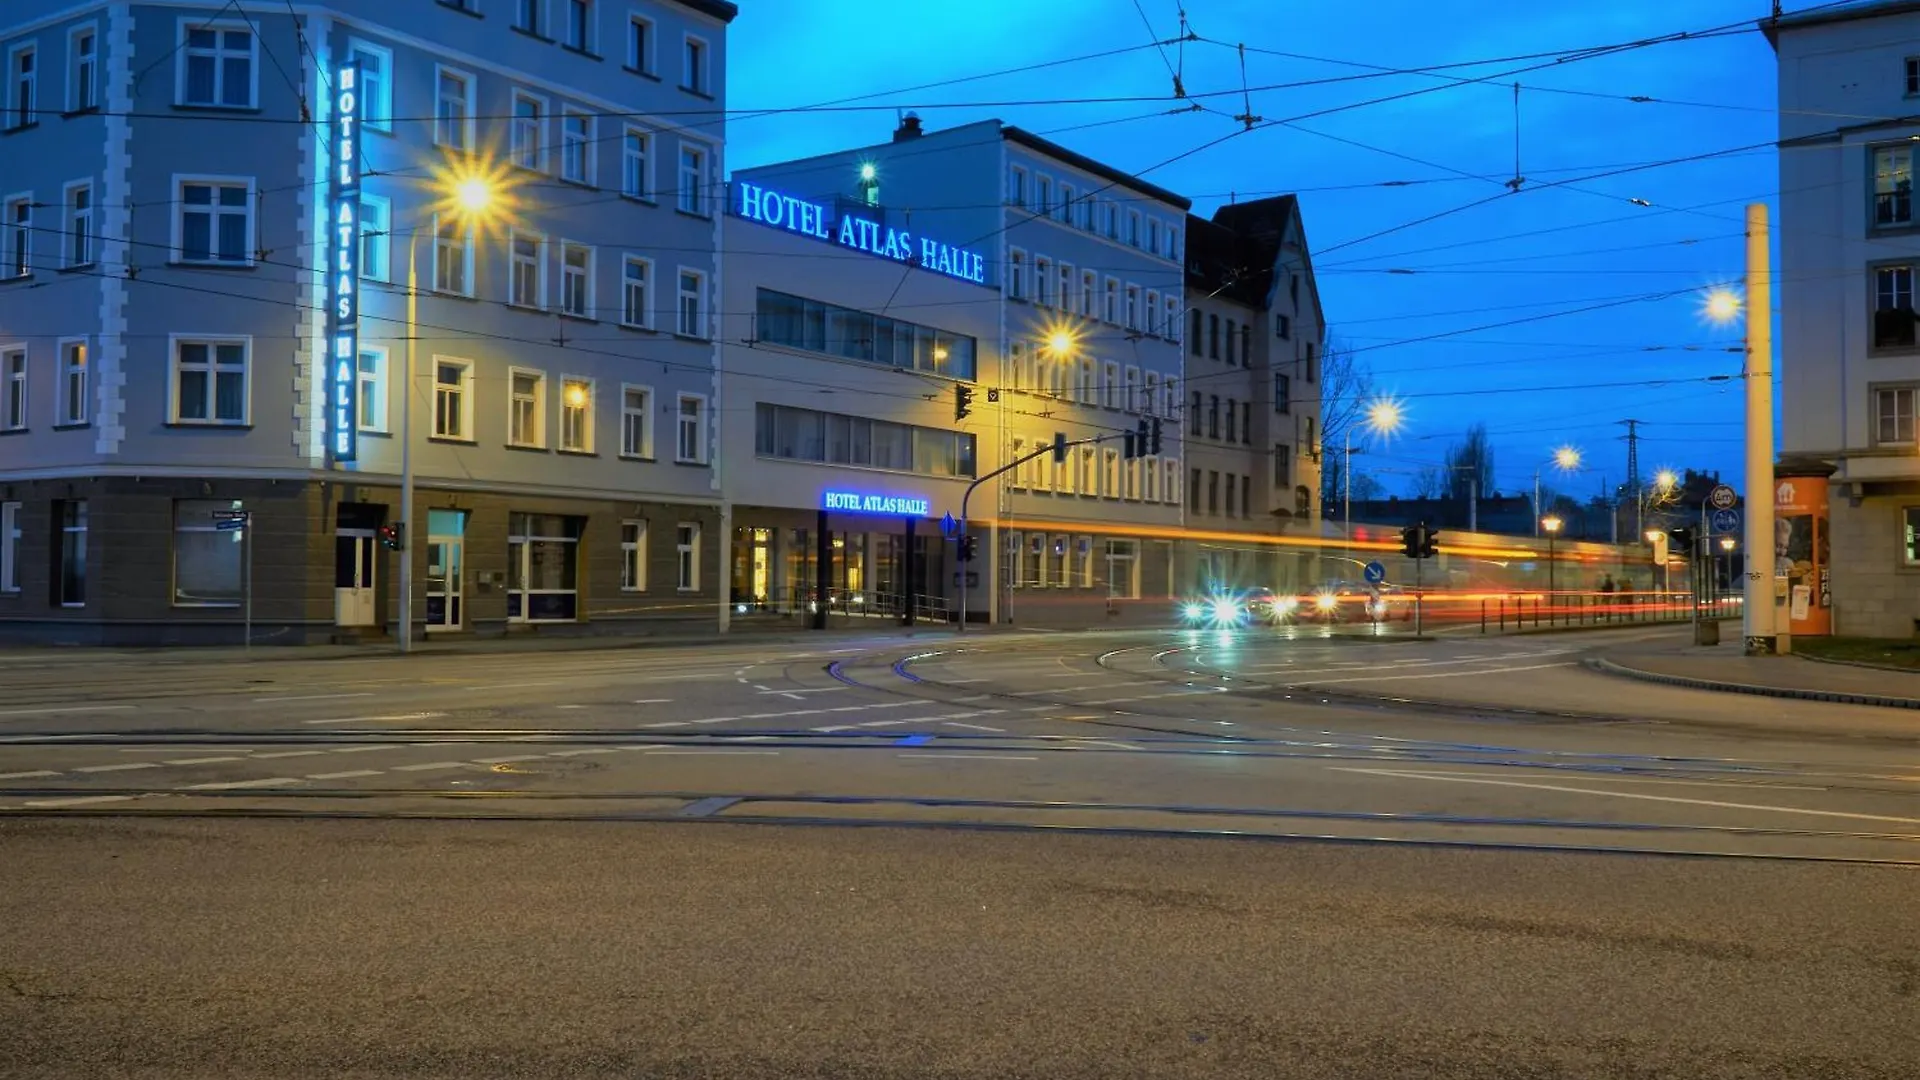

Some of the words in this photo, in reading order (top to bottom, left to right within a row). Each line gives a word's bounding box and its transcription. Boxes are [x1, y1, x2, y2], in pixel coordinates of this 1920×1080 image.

[339, 67, 355, 185] HOTEL
[337, 202, 353, 319] ATLAS
[740, 182, 829, 239] HOTEL
[839, 214, 912, 260] ATLAS
[920, 237, 984, 283] HALLE
[336, 336, 352, 454] HALLE
[826, 492, 862, 510] HOTEL
[863, 496, 897, 513] ATLAS
[897, 499, 928, 515] HALLE
